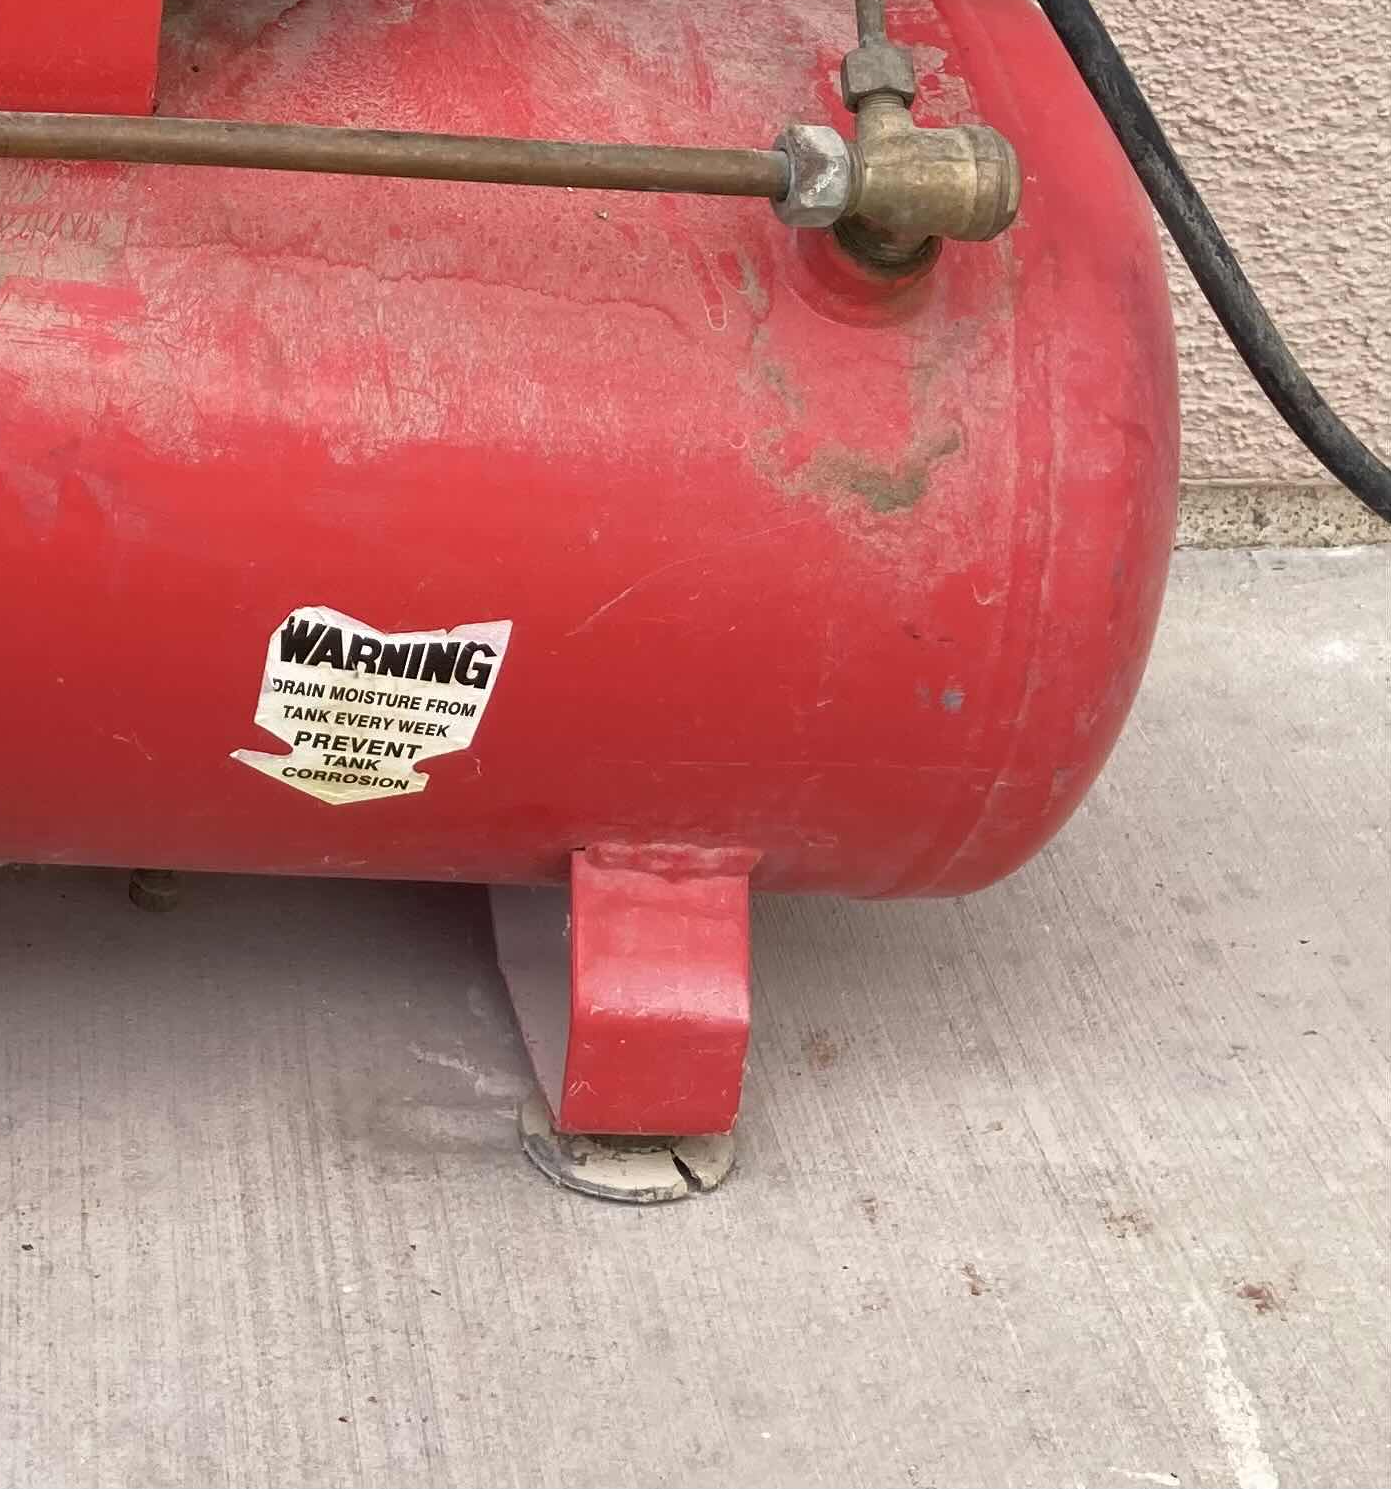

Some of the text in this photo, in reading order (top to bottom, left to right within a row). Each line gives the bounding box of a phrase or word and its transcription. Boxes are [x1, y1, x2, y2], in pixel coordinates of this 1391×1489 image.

[280, 615, 497, 689] WARNING
[272, 678, 477, 718] DRAIN MOISTURE FROM
[283, 705, 450, 738] TANK EVERY WEEK
[293, 730, 423, 760] PREVENT
[281, 766, 410, 790] CORROSION
[322, 754, 381, 772] TANK
